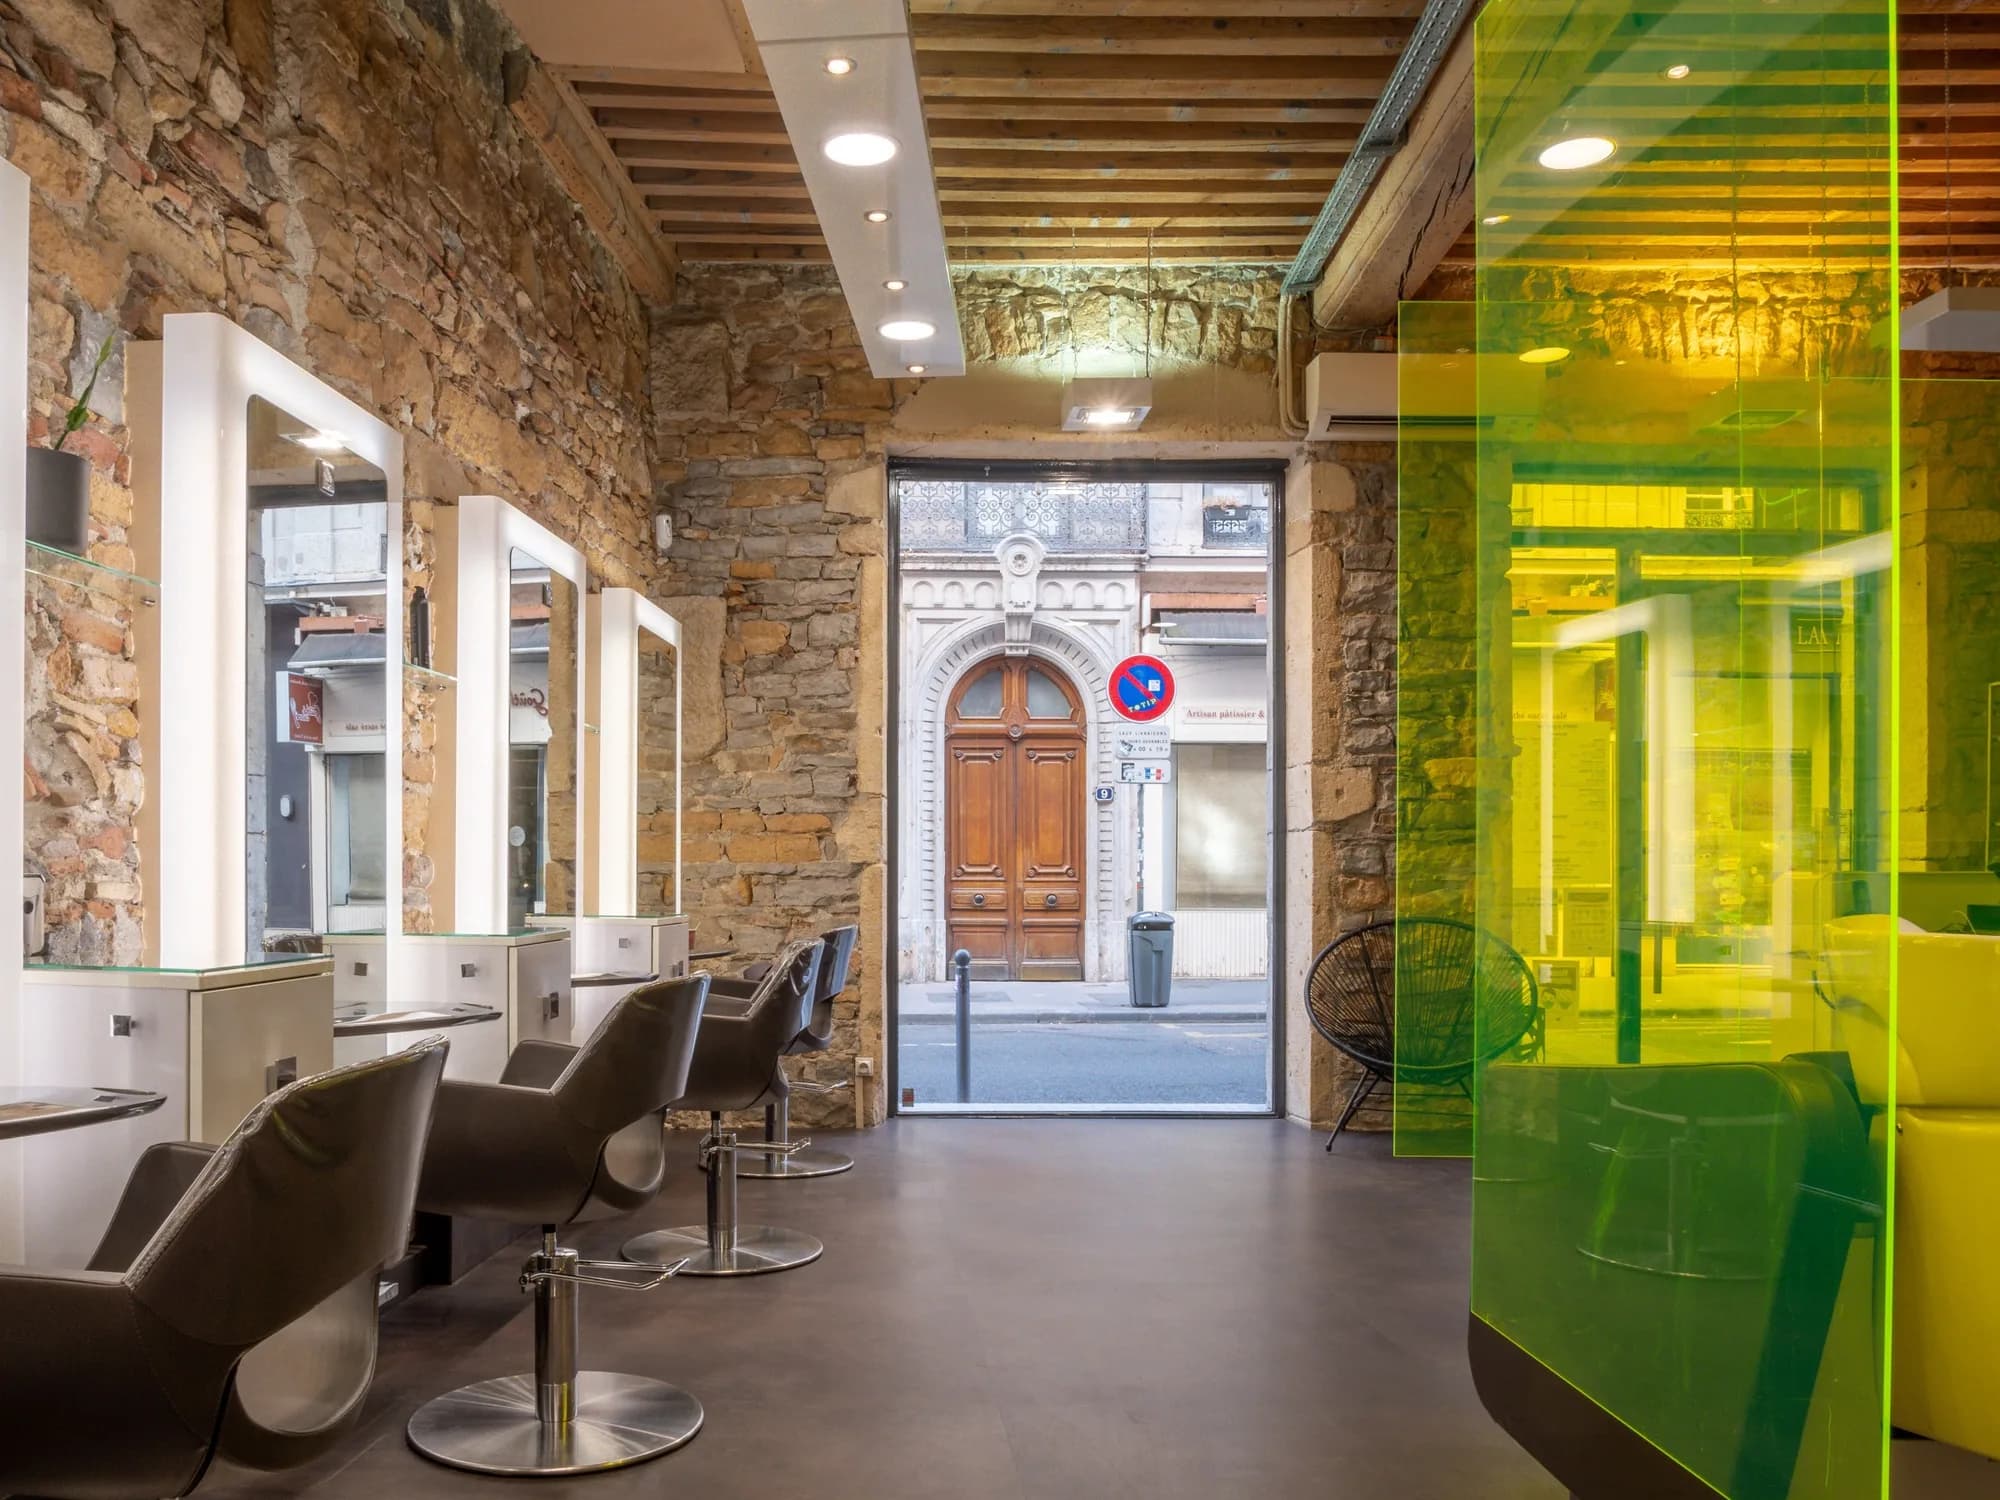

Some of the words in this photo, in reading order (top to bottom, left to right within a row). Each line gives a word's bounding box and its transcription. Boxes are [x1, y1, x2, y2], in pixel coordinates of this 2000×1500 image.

[1186, 709, 1217, 718] Artisan
[1219, 708, 1256, 720] pâtissier
[1258, 710, 1265, 719] &
[1101, 789, 1108, 799] 9
